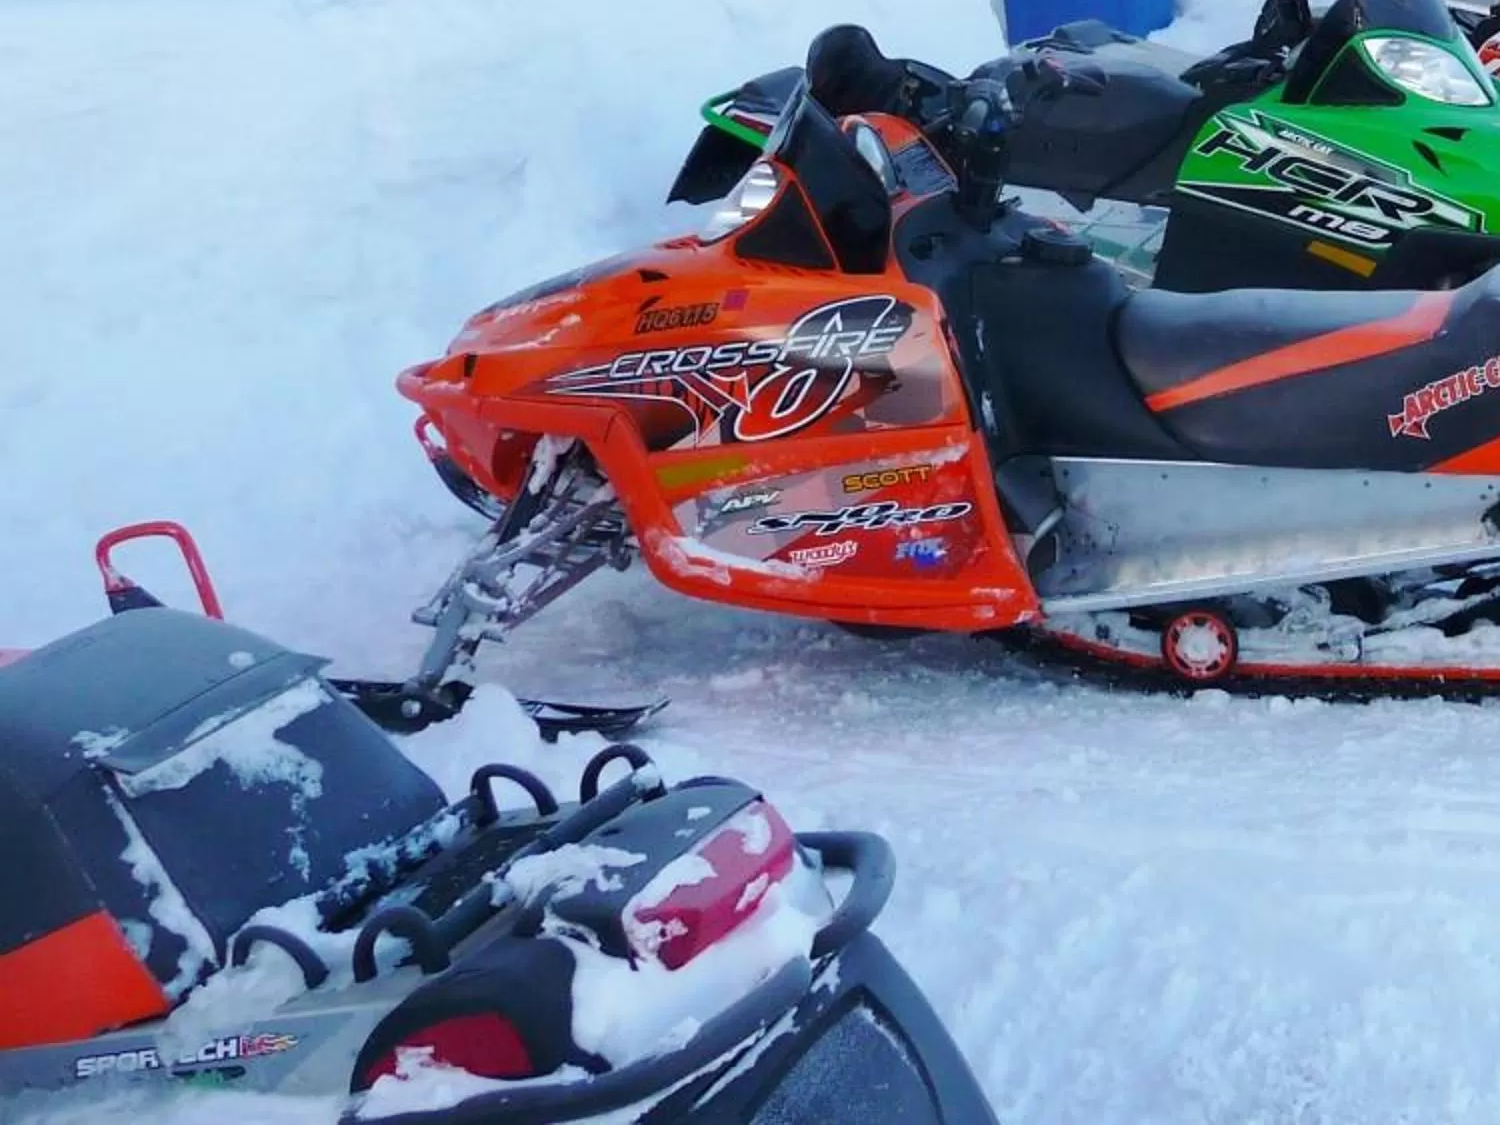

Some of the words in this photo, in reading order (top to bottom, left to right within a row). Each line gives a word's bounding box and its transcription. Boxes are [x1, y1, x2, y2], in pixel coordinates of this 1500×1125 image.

[609, 313, 904, 378] CROSSFIRE
[1403, 365, 1484, 425] ARCTIC
[843, 466, 933, 492] SCOTT
